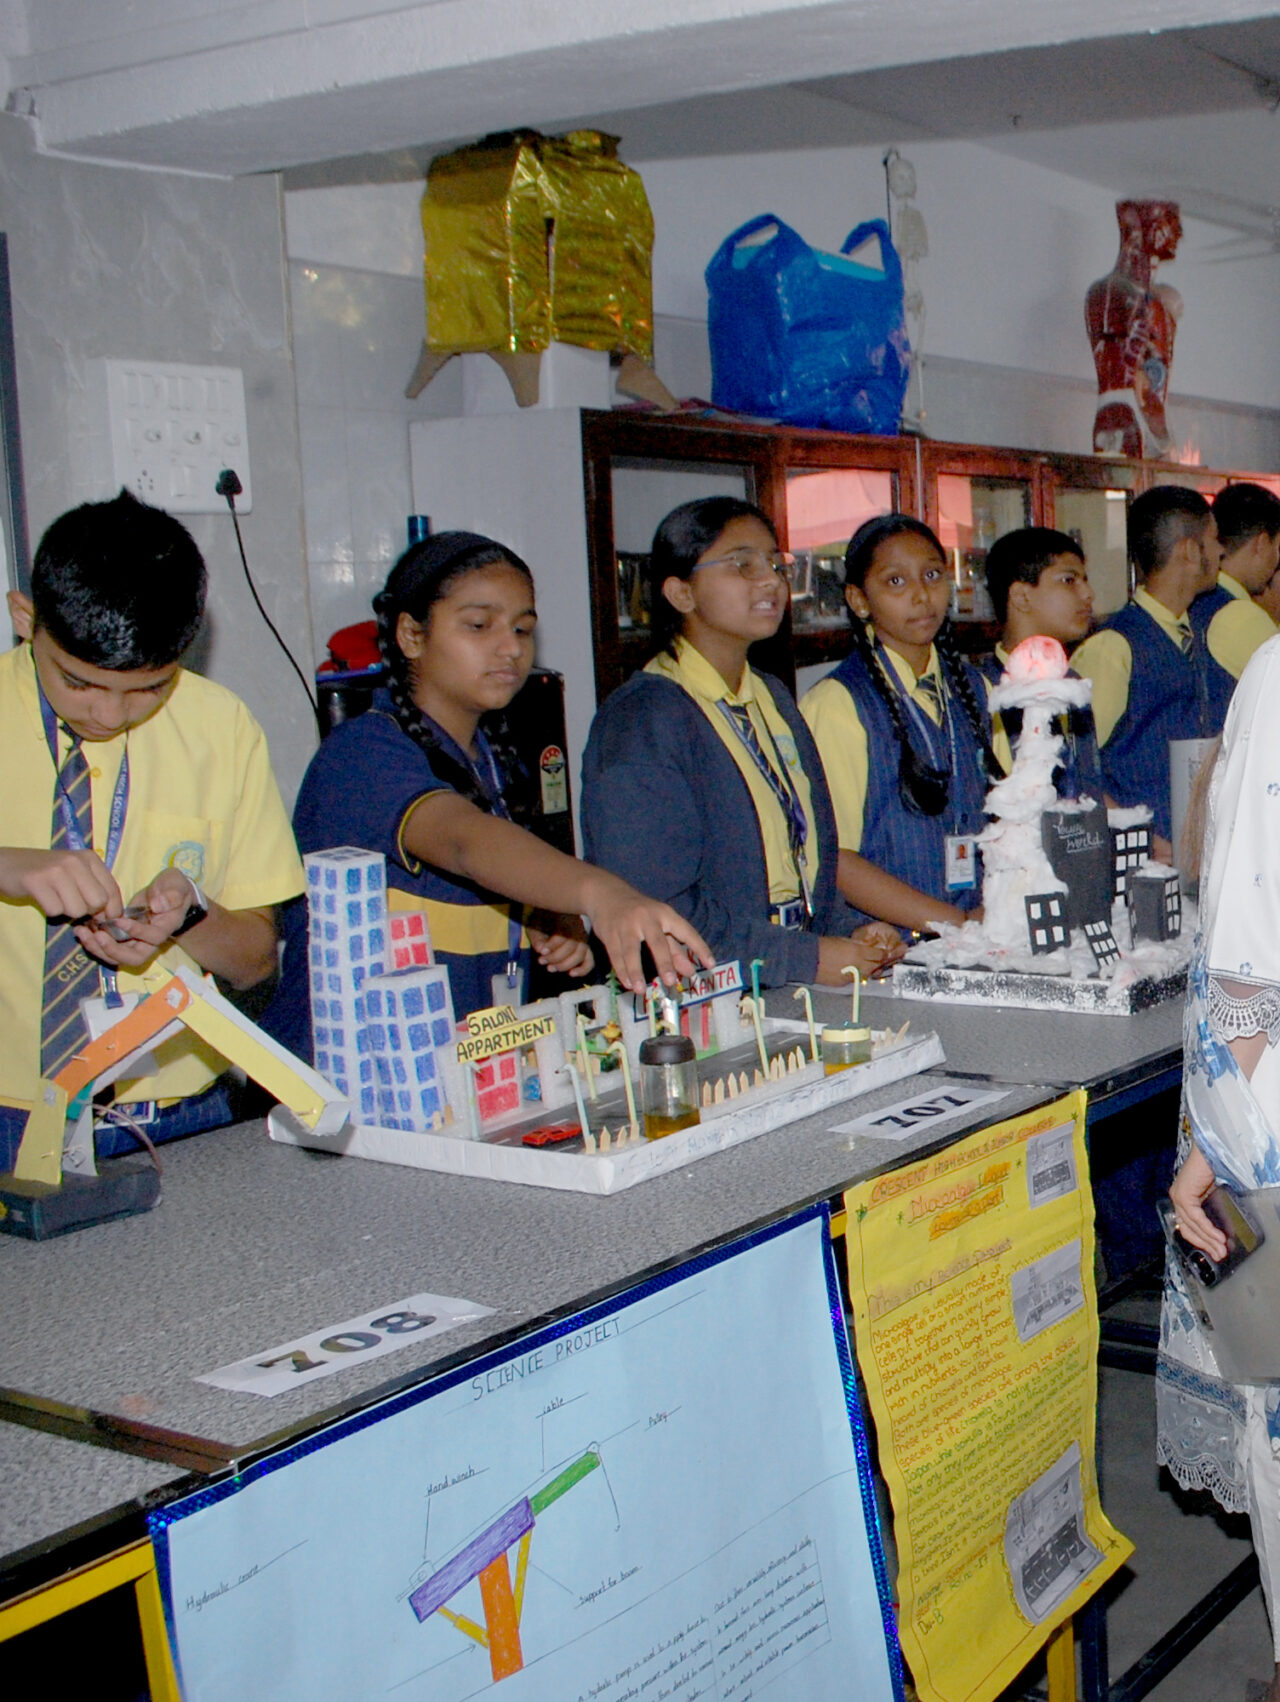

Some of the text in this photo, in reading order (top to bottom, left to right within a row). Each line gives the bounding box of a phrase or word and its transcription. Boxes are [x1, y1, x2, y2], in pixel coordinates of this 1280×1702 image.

[456, 1017, 554, 1060] APPARTMENT
[467, 1005, 517, 1036] SALONI
[869, 1095, 972, 1128] 707
[256, 1310, 437, 1373] 708
[472, 1316, 621, 1400] SCIENCE PROJECT
